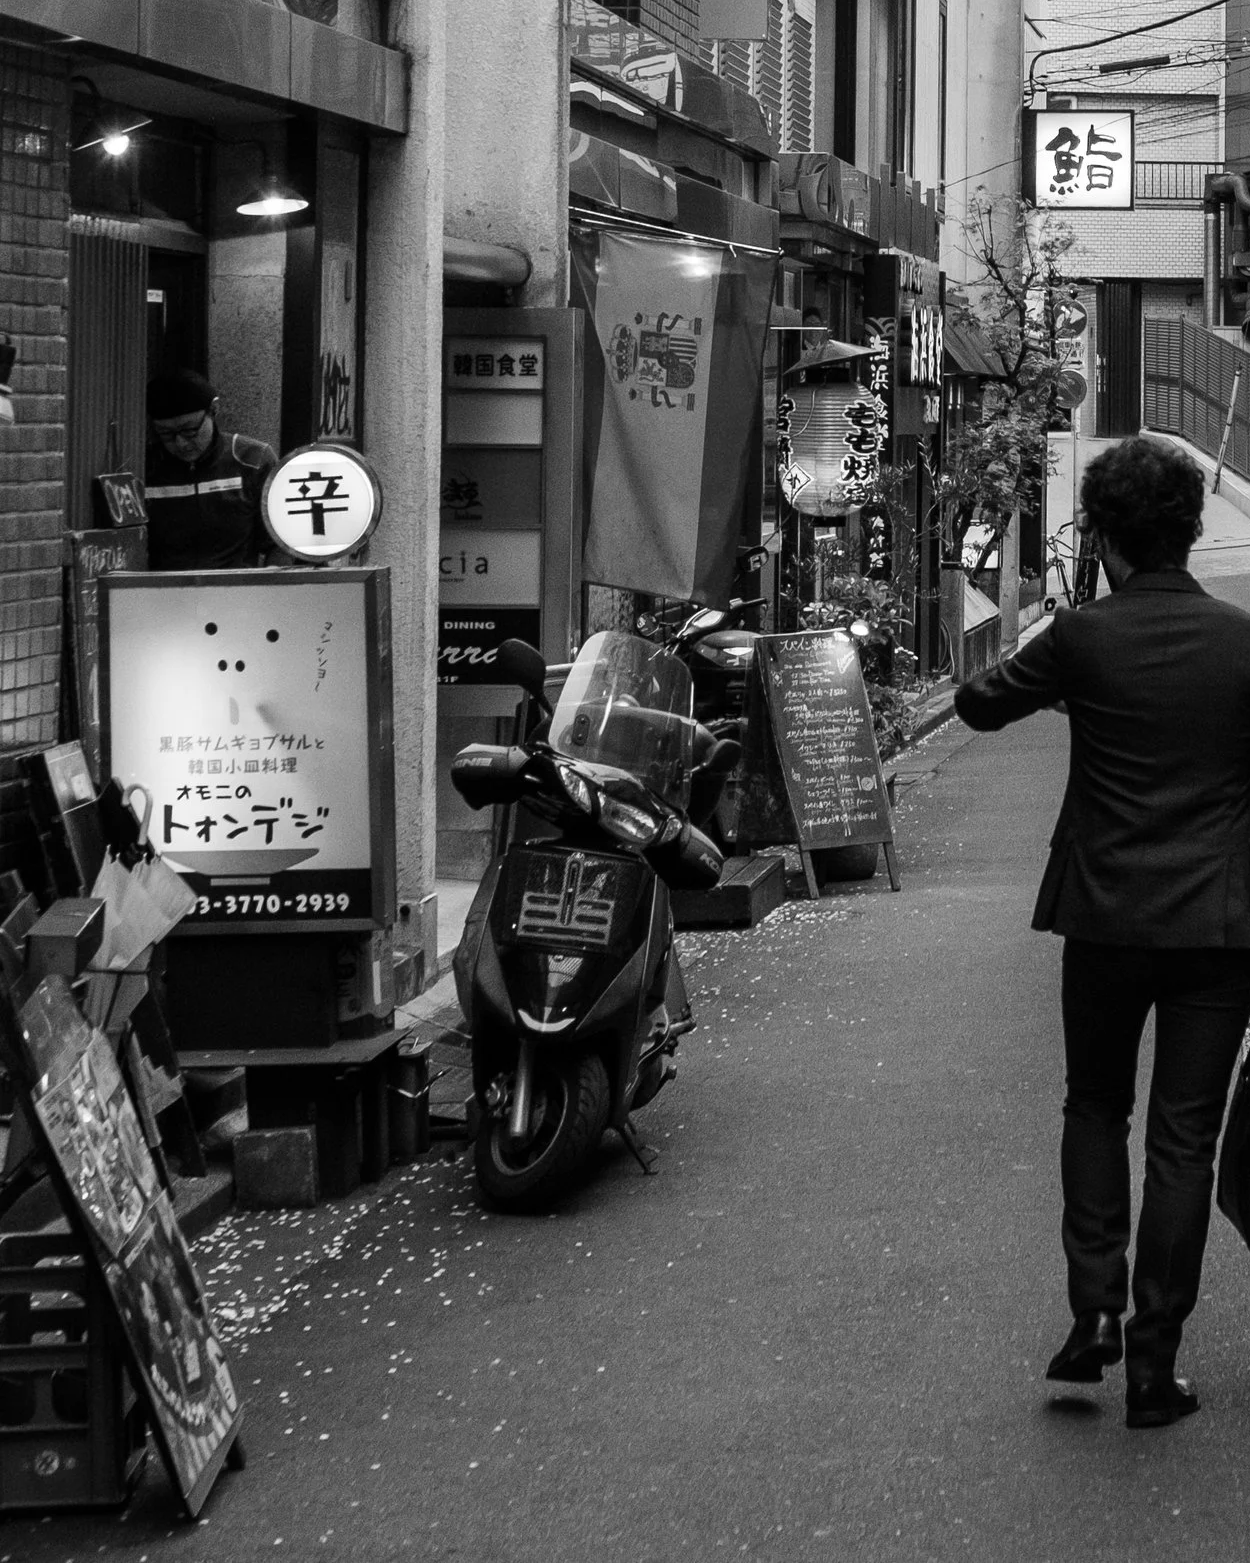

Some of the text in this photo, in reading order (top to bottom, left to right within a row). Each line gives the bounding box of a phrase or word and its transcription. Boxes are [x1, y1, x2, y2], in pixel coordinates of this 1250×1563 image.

[1045, 126, 1122, 195] 鮨
[454, 353, 539, 377] 韓国食堂
[285, 471, 350, 536] 辛
[438, 550, 489, 575] cia
[444, 621, 496, 630] DINING
[187, 756, 298, 775] 韓国小皿料理
[176, 784, 252, 801] オモニの
